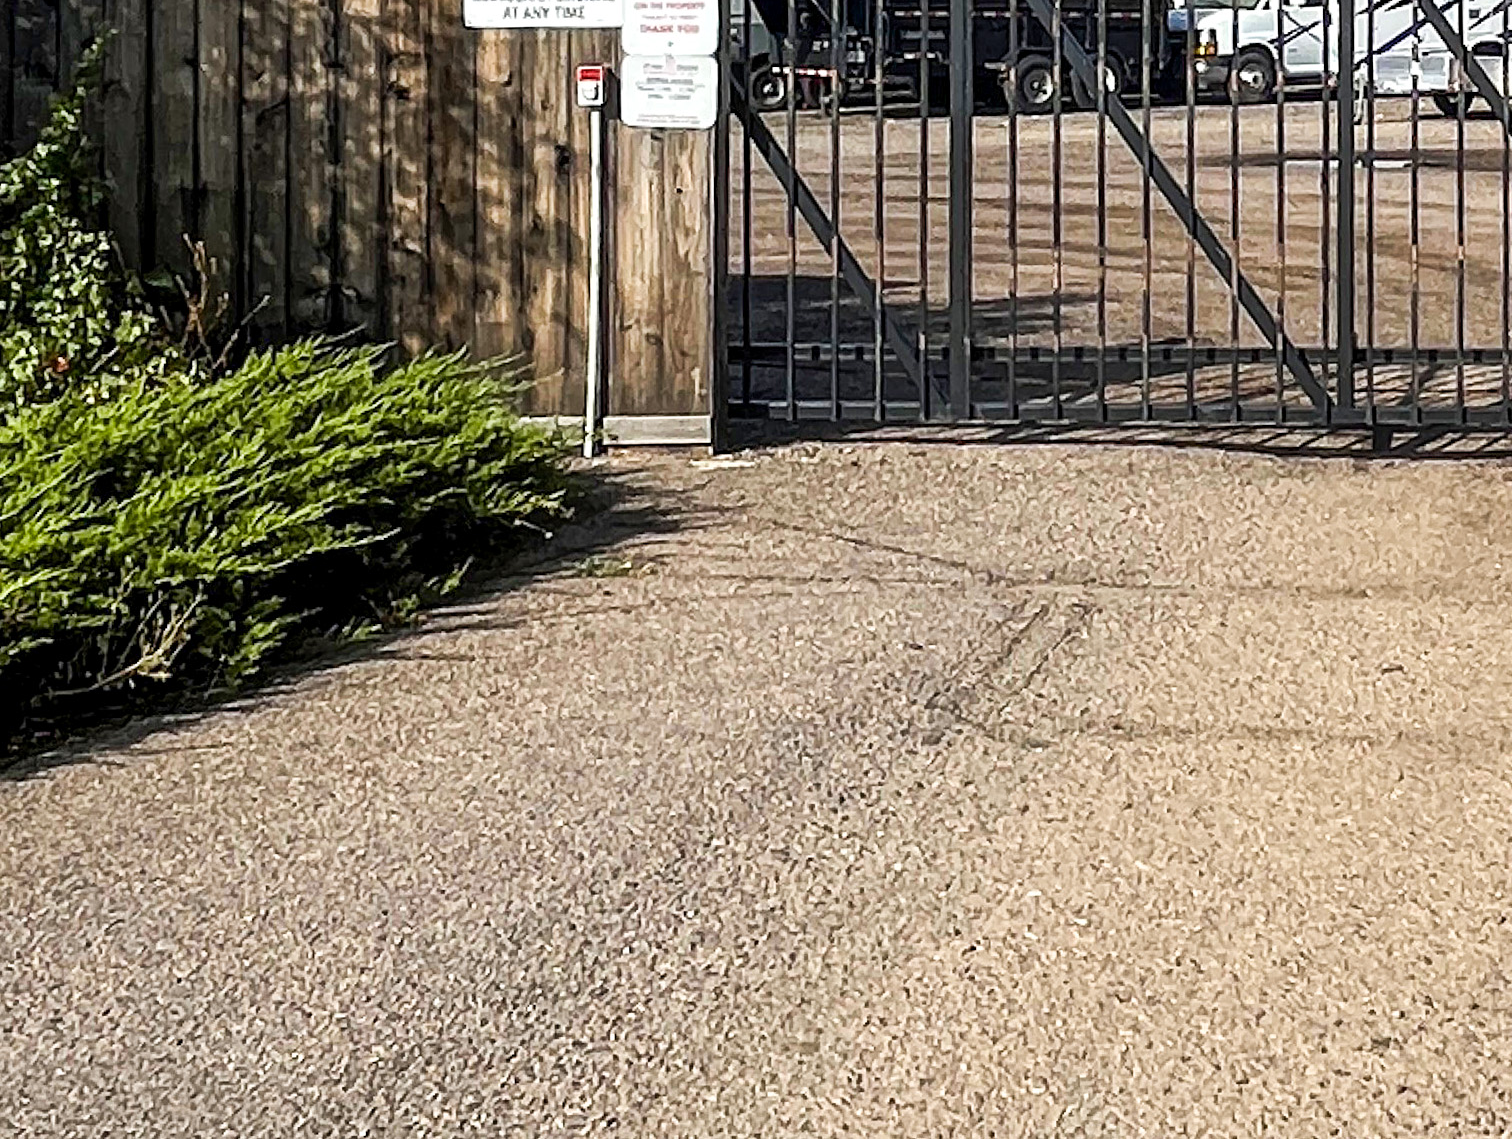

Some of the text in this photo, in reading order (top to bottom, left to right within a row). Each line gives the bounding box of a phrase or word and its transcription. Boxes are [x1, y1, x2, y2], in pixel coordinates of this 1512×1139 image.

[503, 5, 585, 19] AT ANY TIME
